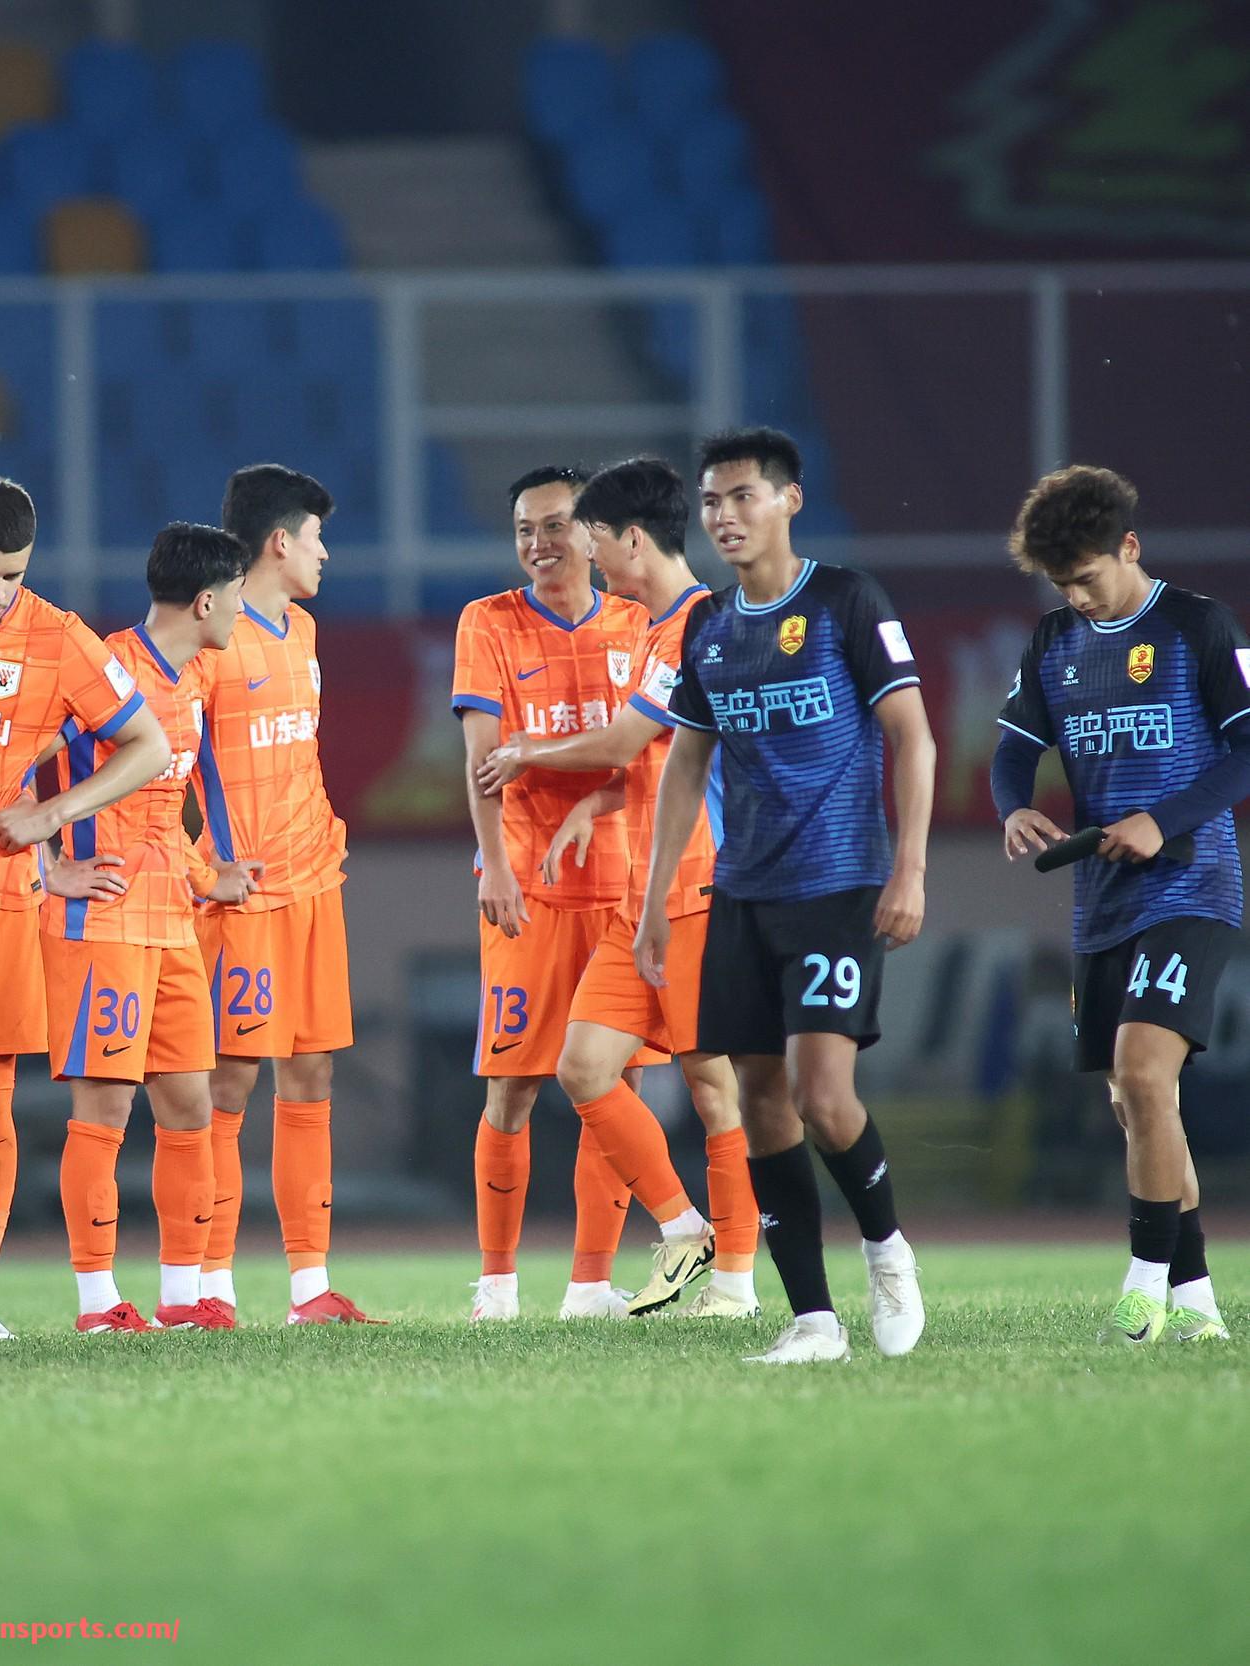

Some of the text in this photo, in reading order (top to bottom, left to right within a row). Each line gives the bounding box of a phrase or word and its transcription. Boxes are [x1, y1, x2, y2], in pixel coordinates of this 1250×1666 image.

[250, 709, 320, 749] 山东泰
[227, 966, 273, 1016] 28
[801, 953, 861, 1009] 29
[1127, 952, 1188, 1004] 44
[93, 988, 141, 1039] 30
[491, 986, 528, 1035] 13
